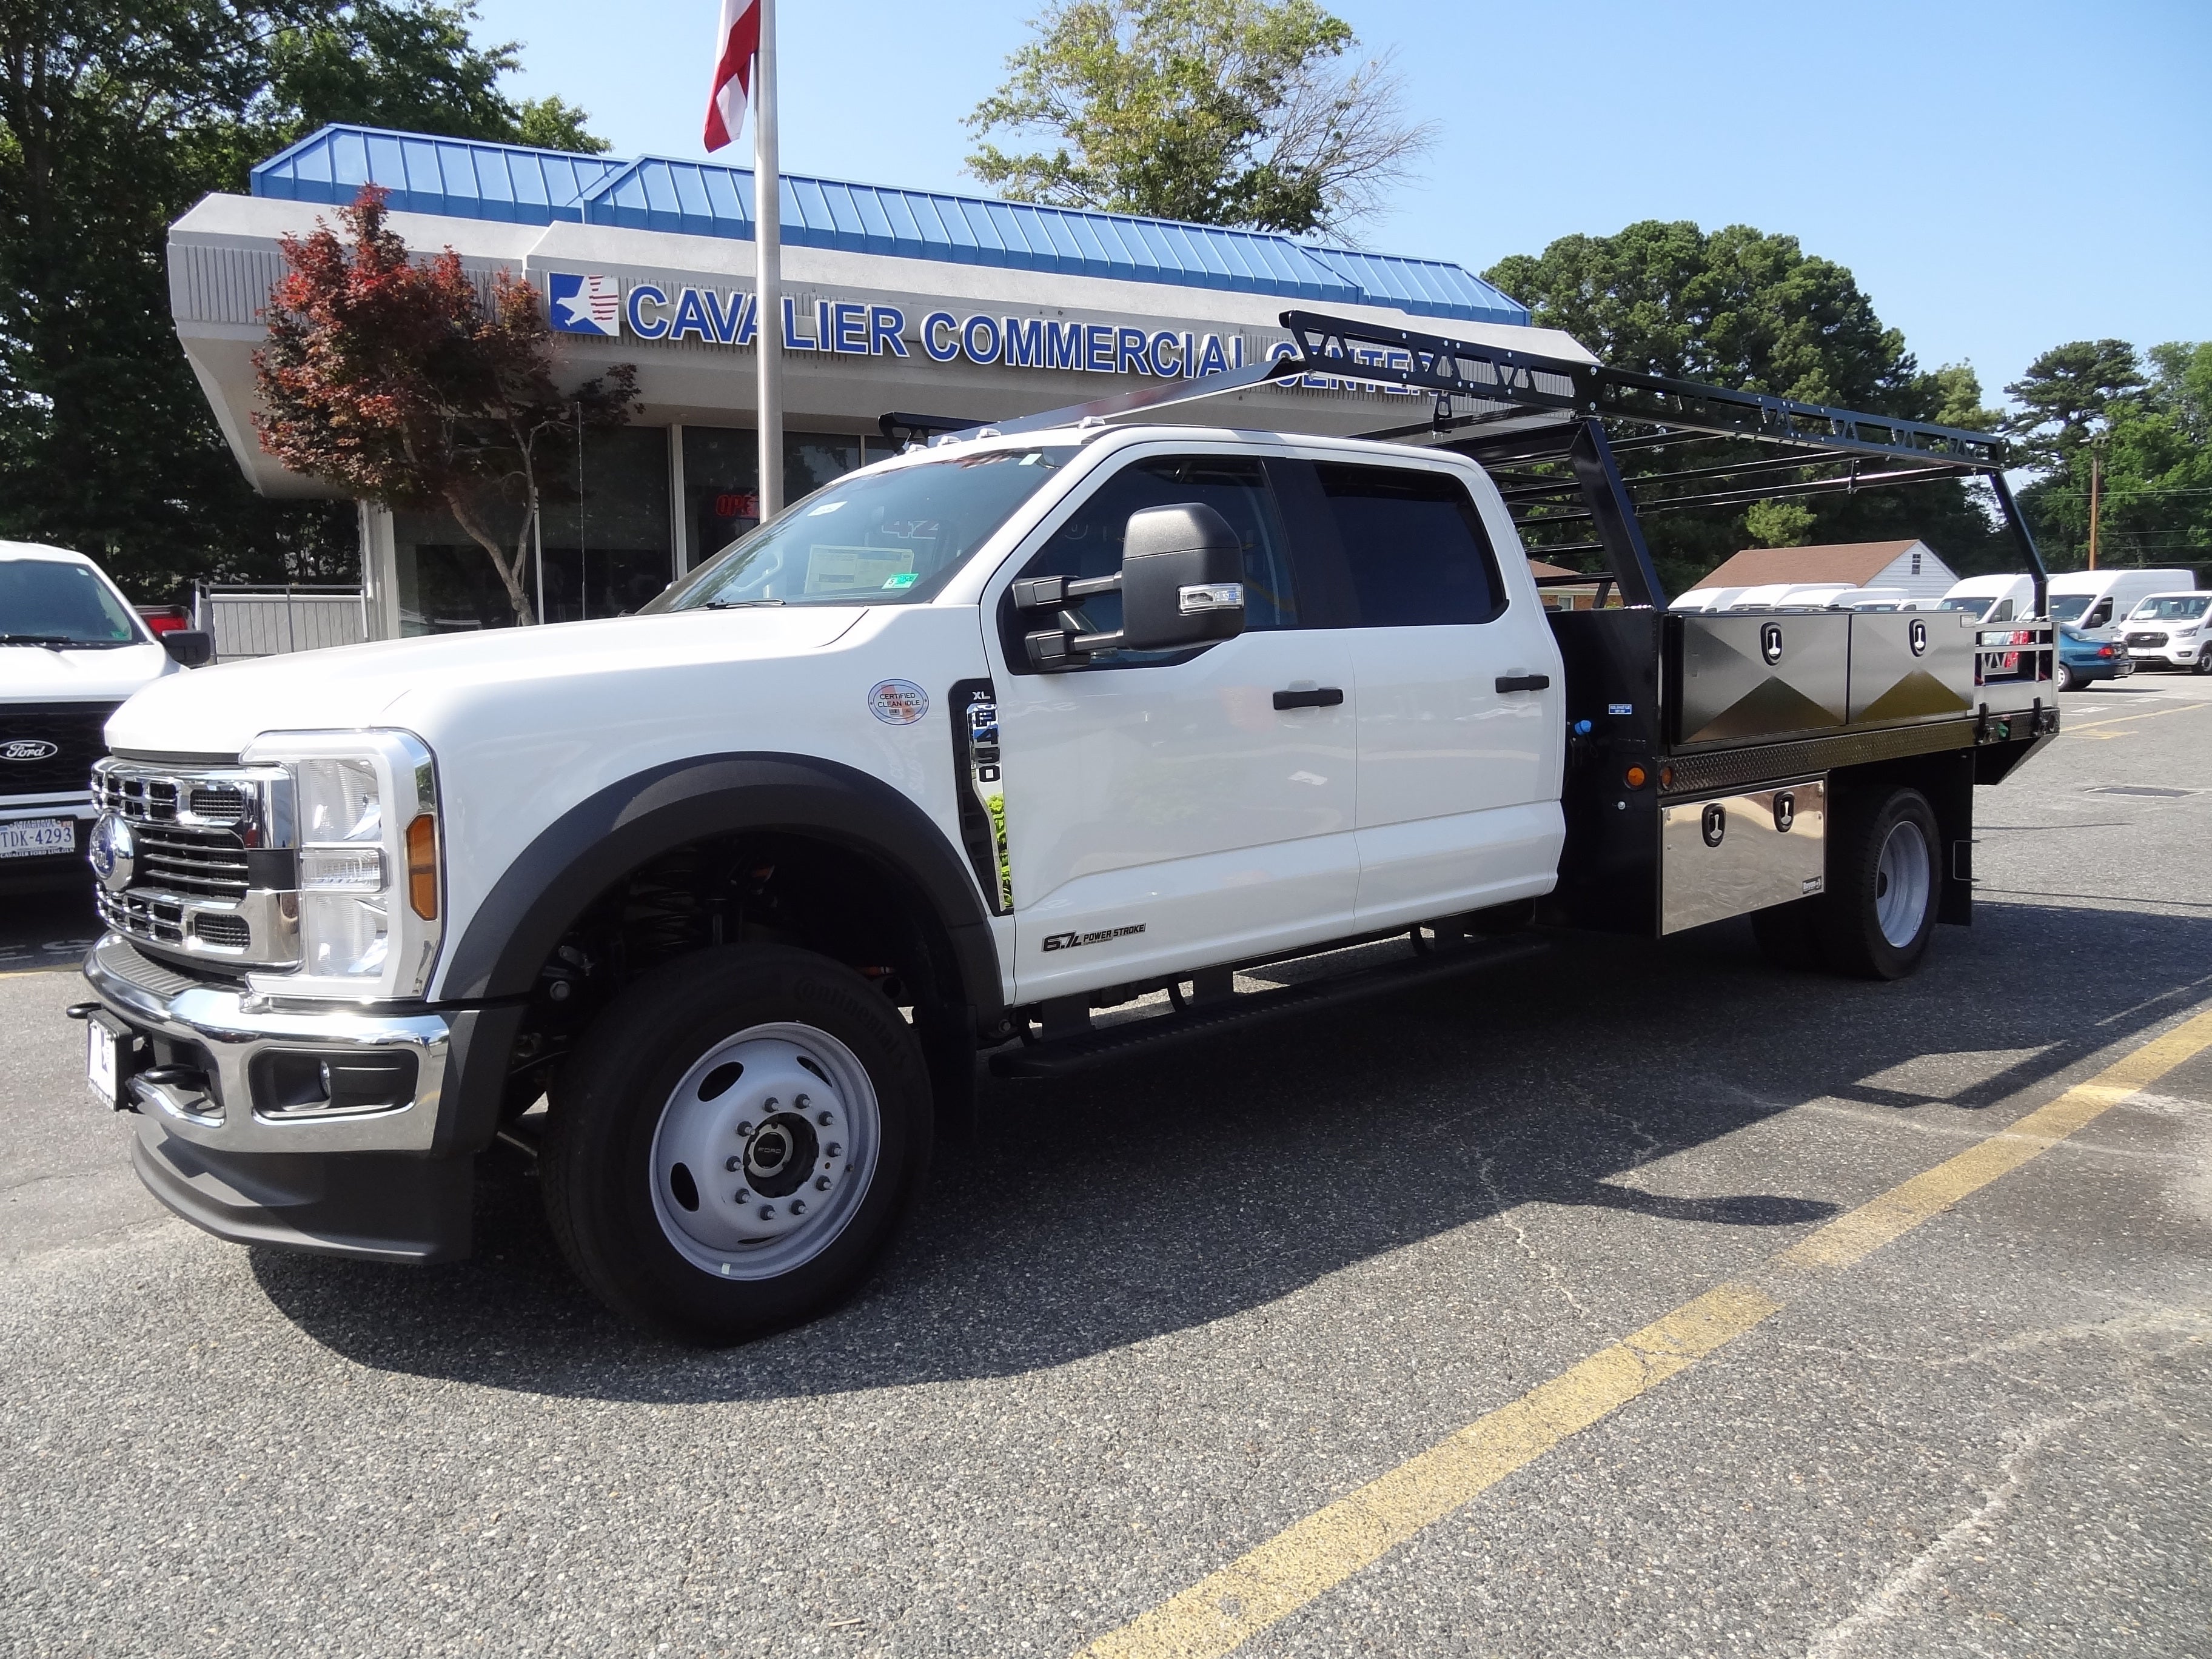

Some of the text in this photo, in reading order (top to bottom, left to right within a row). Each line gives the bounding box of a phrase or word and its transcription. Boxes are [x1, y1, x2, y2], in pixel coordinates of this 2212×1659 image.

[972, 691, 990, 700] XL
[6, 743, 45, 757] Ford
[1, 827, 72, 848] TDK-4293
[1043, 931, 1082, 952] 6.7L
[1084, 930, 1112, 942] POWER
[1113, 924, 1145, 937] STROKE
